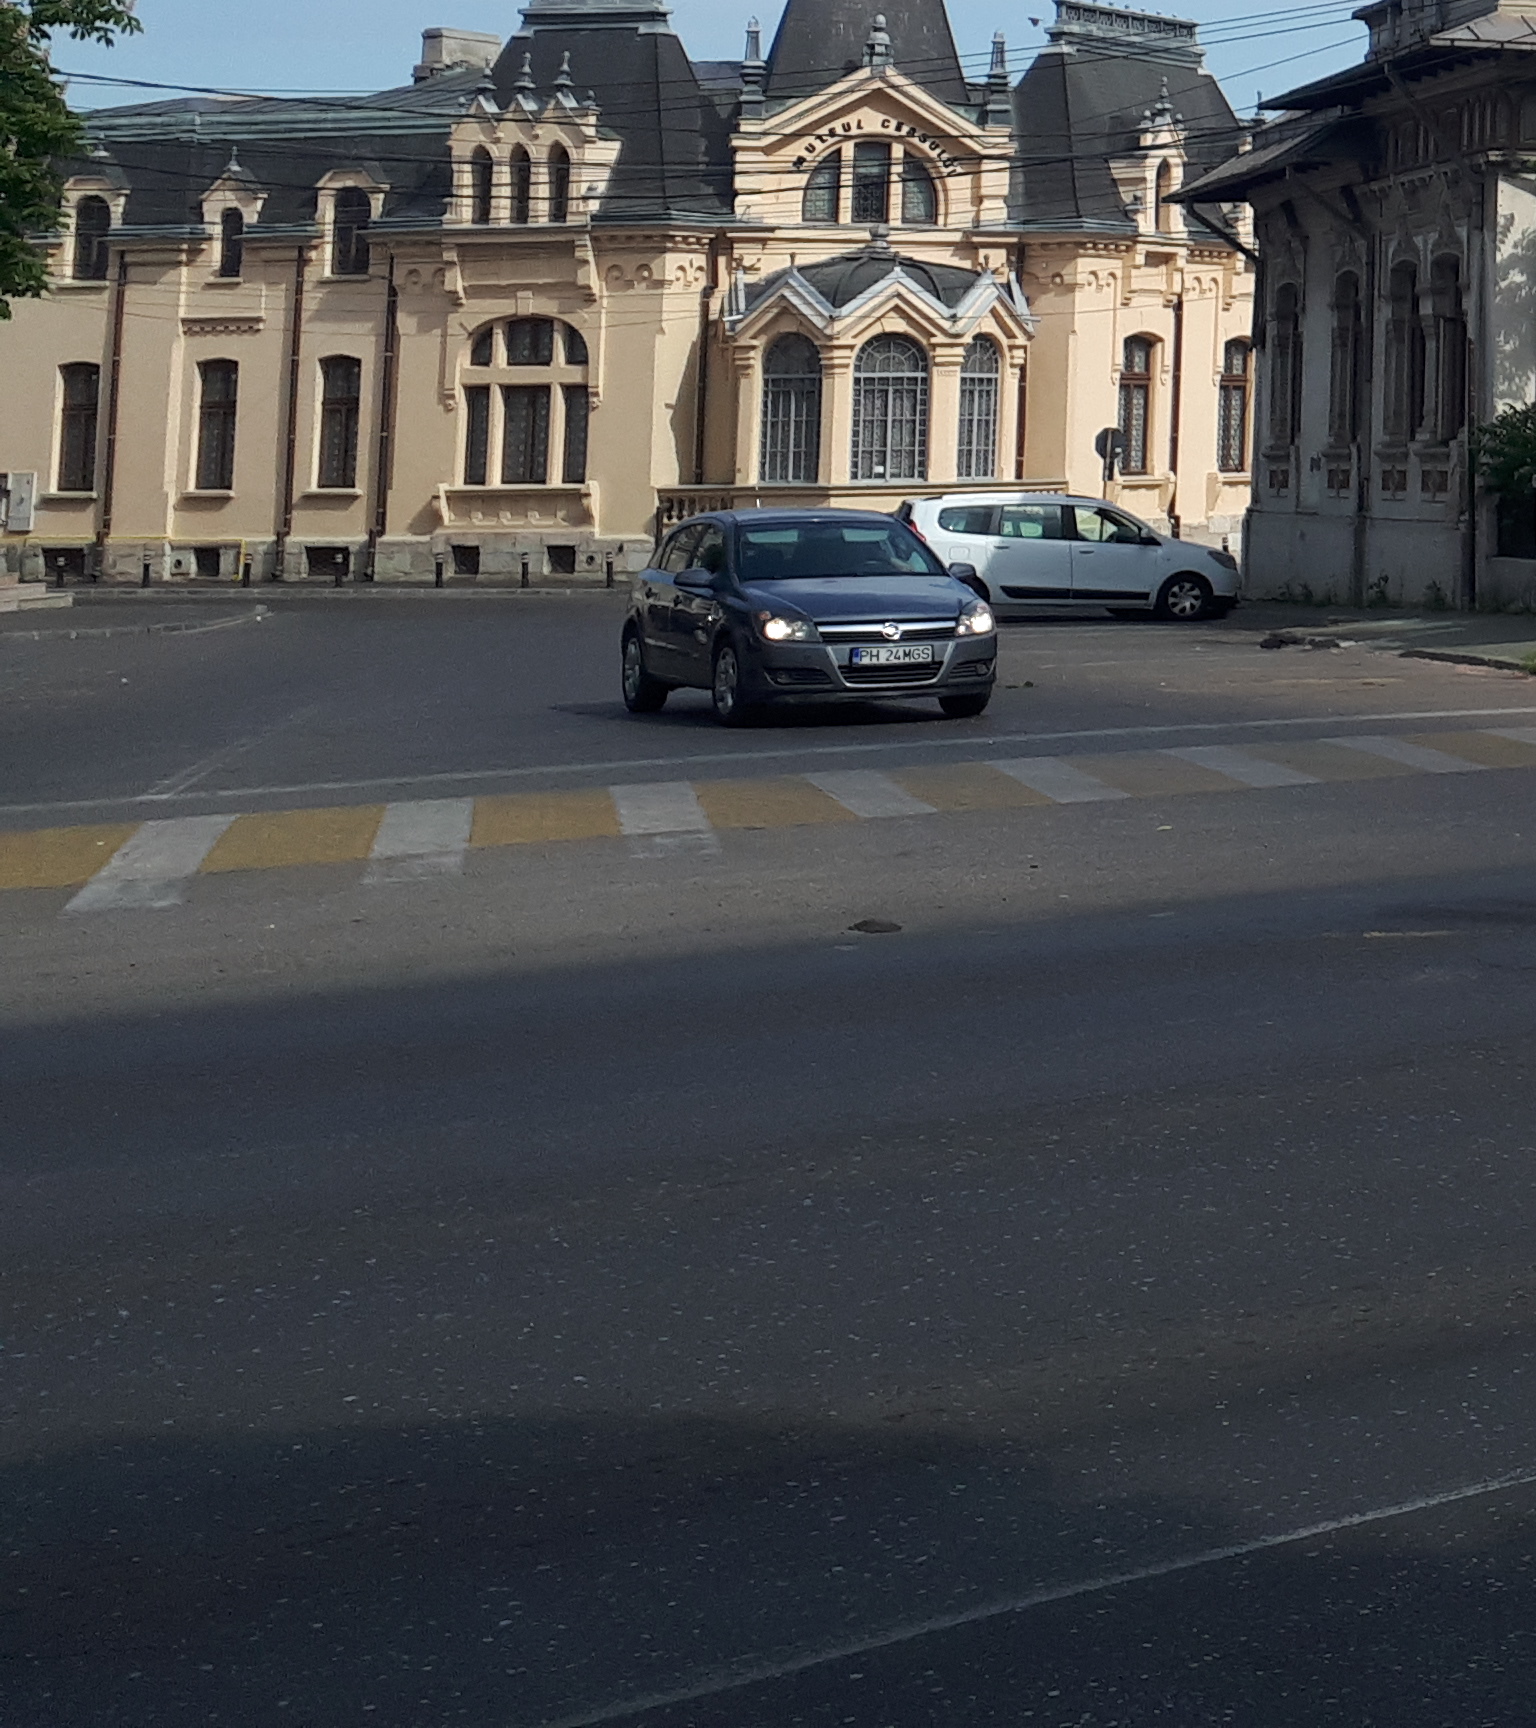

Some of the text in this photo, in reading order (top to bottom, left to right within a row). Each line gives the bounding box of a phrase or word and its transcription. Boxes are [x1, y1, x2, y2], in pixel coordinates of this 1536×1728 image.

[792, 119, 957, 176] MUZEUL CEASULUI
[860, 649, 880, 662] PH
